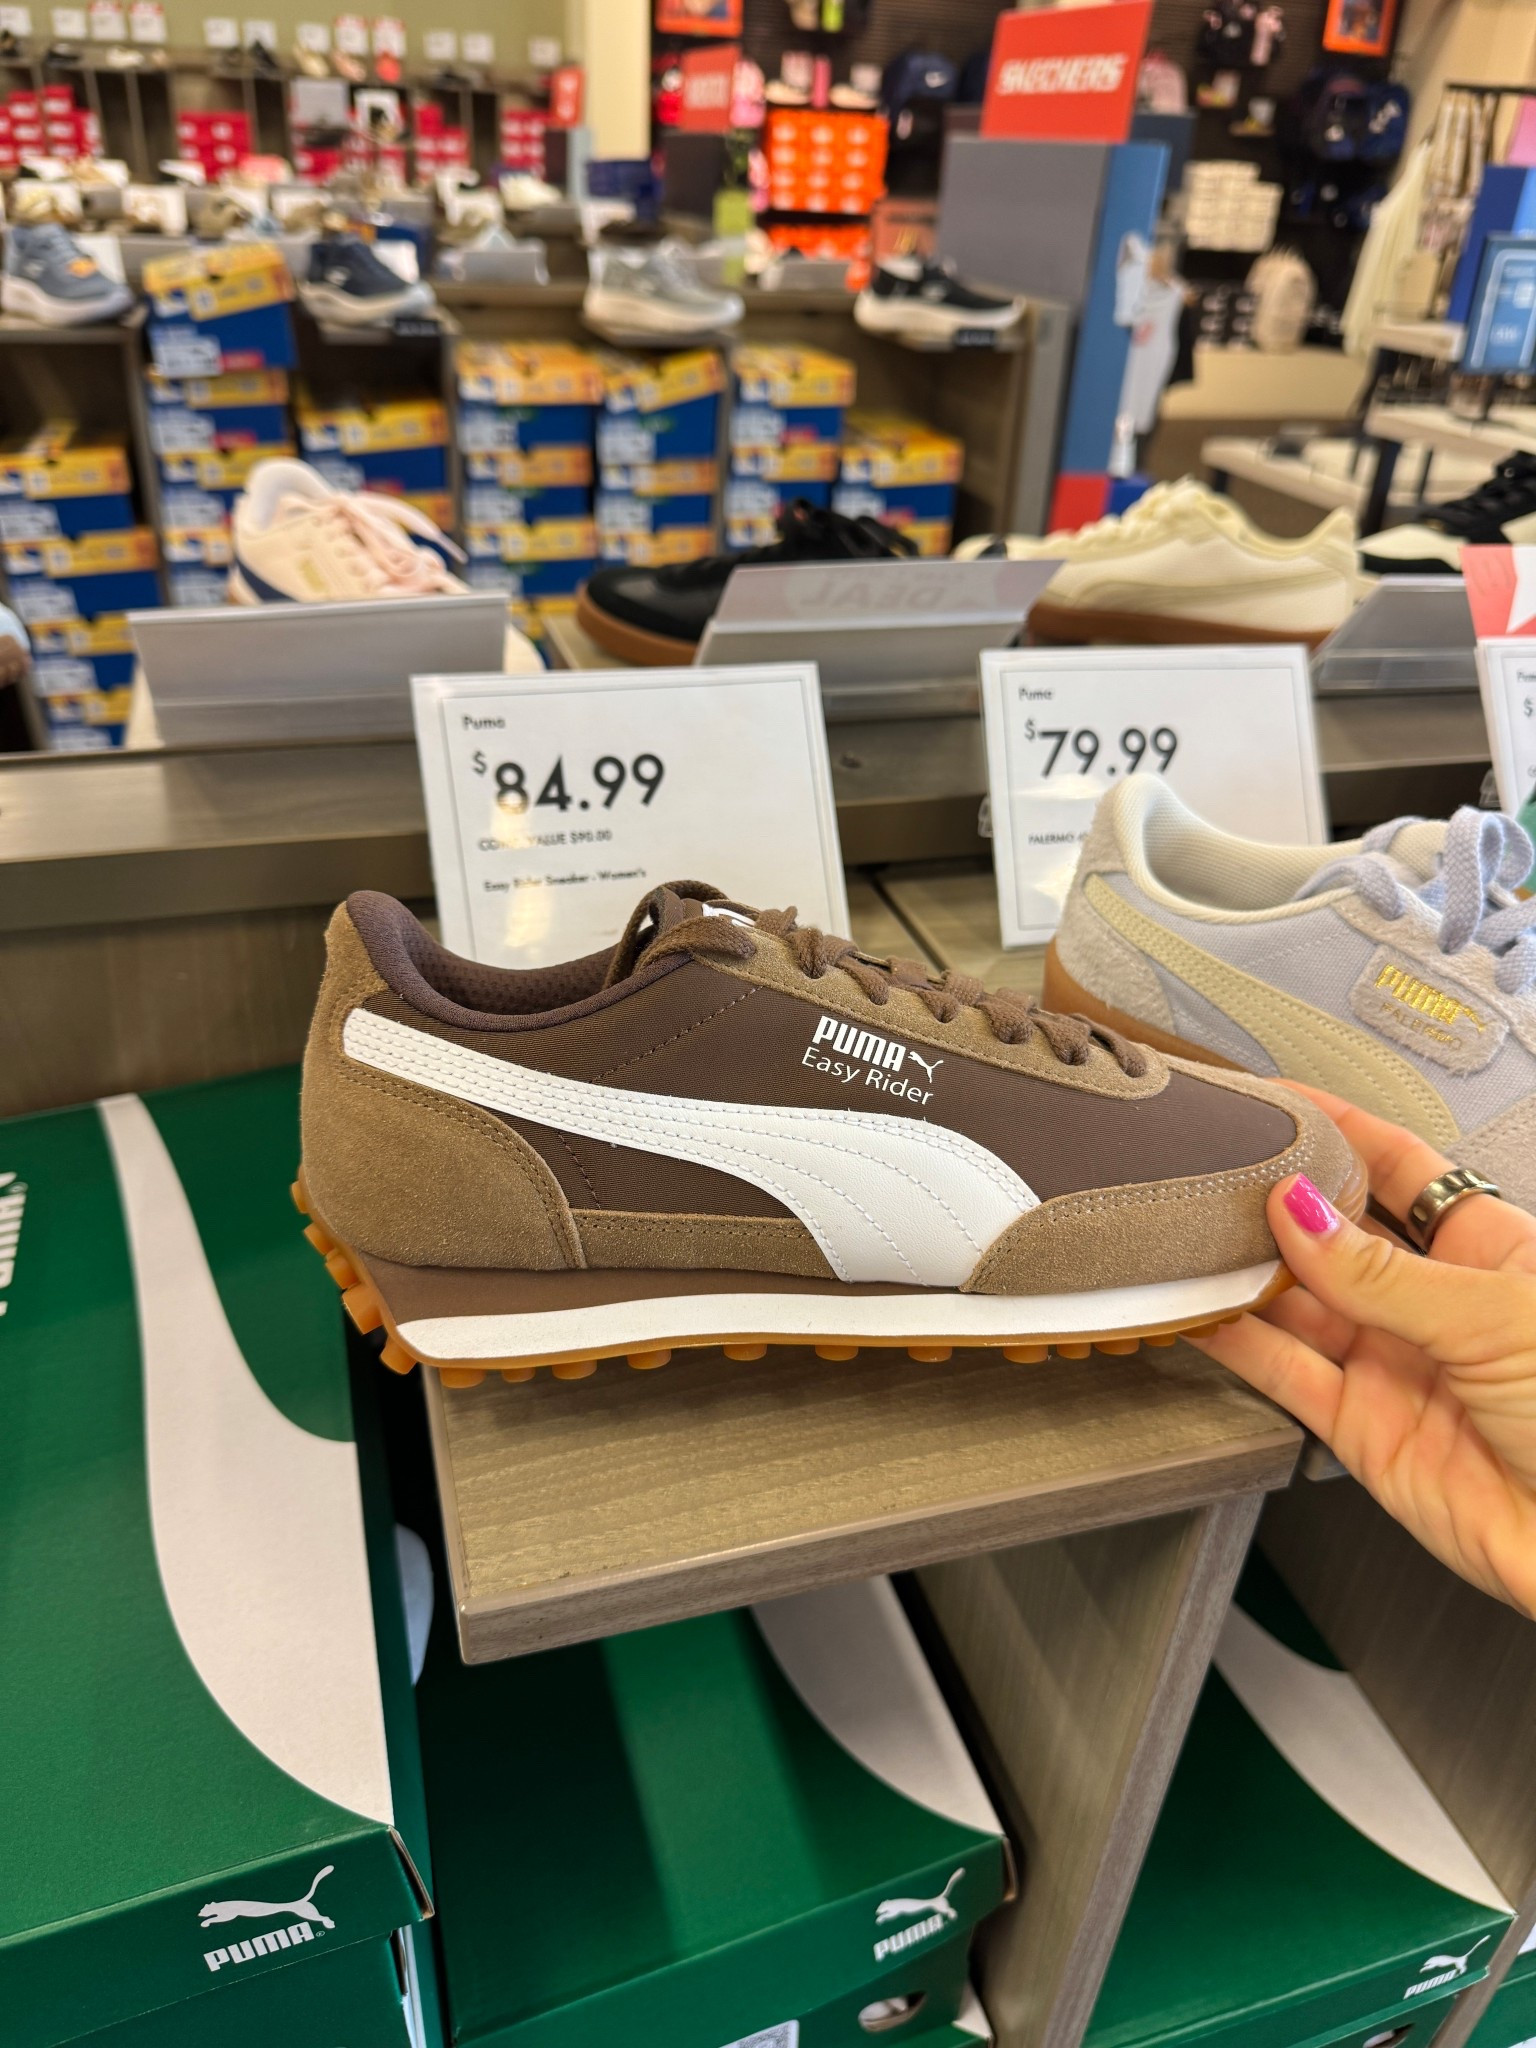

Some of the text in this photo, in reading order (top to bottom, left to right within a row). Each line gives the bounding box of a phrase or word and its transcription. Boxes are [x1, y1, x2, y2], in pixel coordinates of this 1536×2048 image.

[1018, 687, 1053, 701] Puma
[462, 714, 505, 730] Puma
[472, 750, 665, 815] $84.99
[1028, 831, 1074, 846] PALERMO
[812, 1015, 906, 1072] PUMA
[801, 1046, 934, 1105] Easy Rider
[203, 1921, 315, 1973] PUMA
[873, 1912, 945, 1962] PUMA
[1403, 1969, 1458, 2000] PUMA
